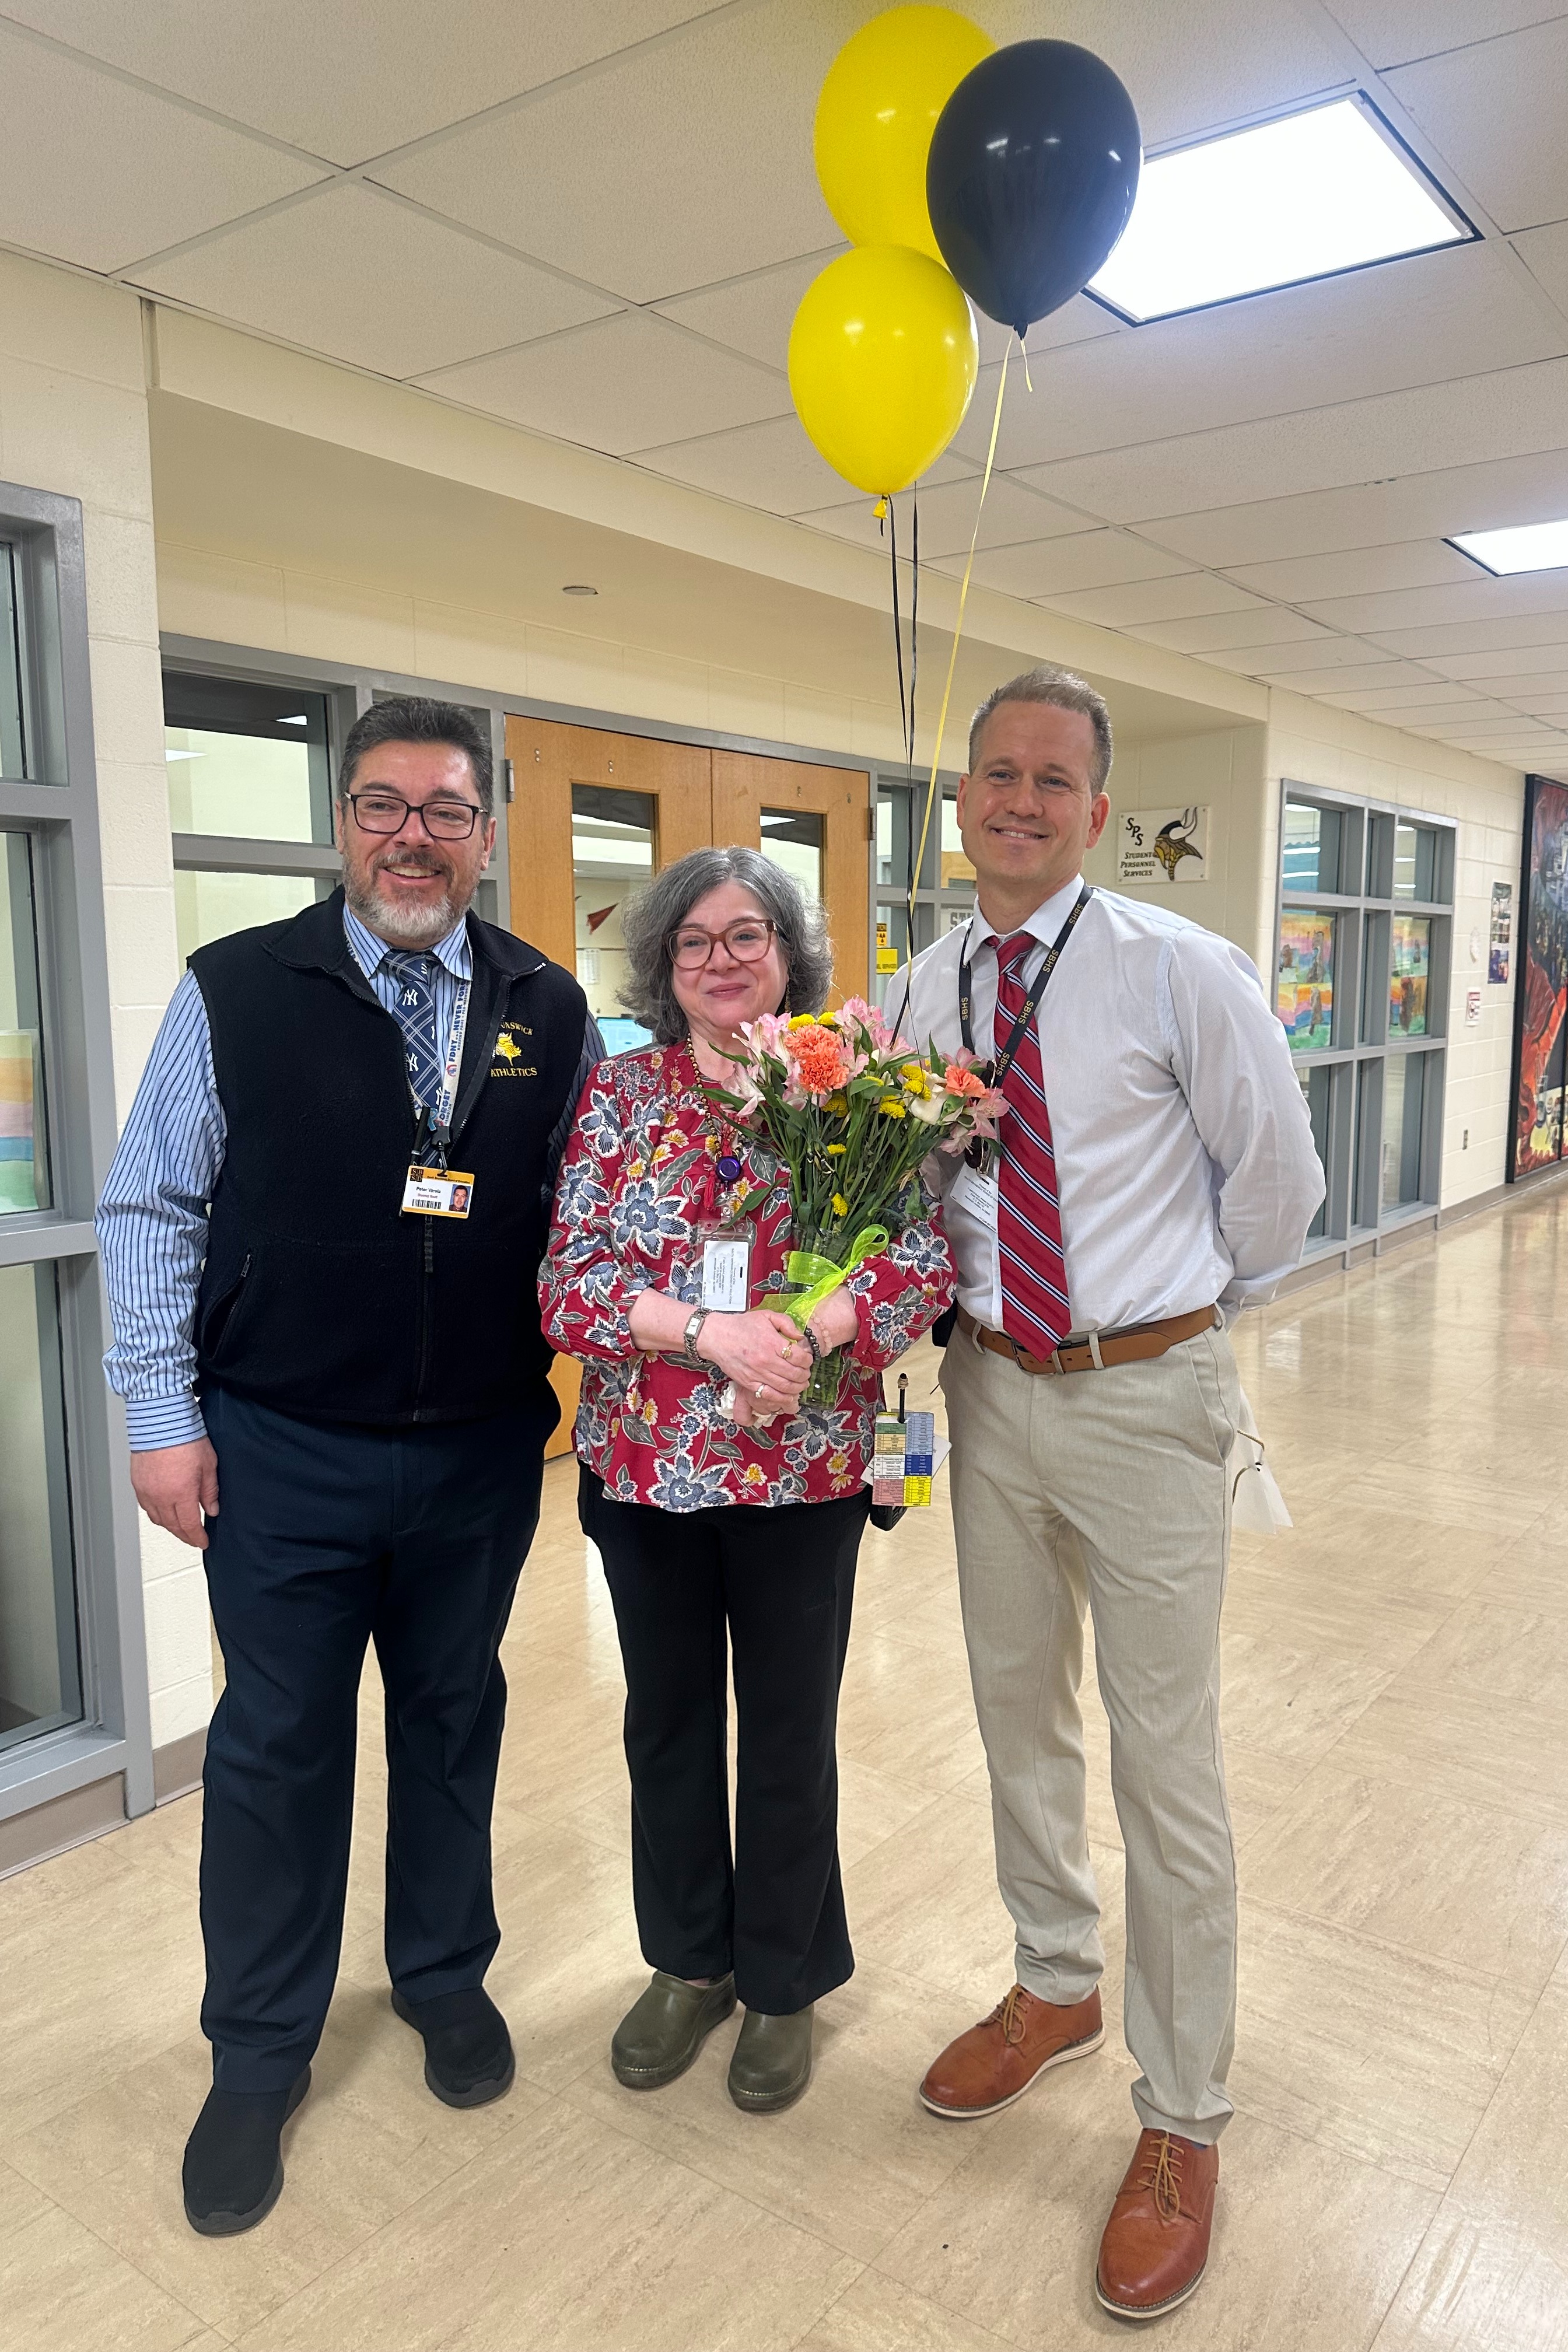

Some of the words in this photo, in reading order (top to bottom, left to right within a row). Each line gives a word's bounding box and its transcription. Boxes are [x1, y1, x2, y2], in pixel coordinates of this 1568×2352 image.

[1069, 904, 1084, 925] SBHS
[1043, 949, 1059, 973] SBHS
[402, 988, 418, 1006] NY
[1018, 1000, 1034, 1024] SBHS
[500, 1021, 534, 1035] UNSWICK
[491, 1067, 537, 1077] ATHLETICS
[996, 1052, 1010, 1076] SBHS
[439, 1089, 451, 1120] ORGET
